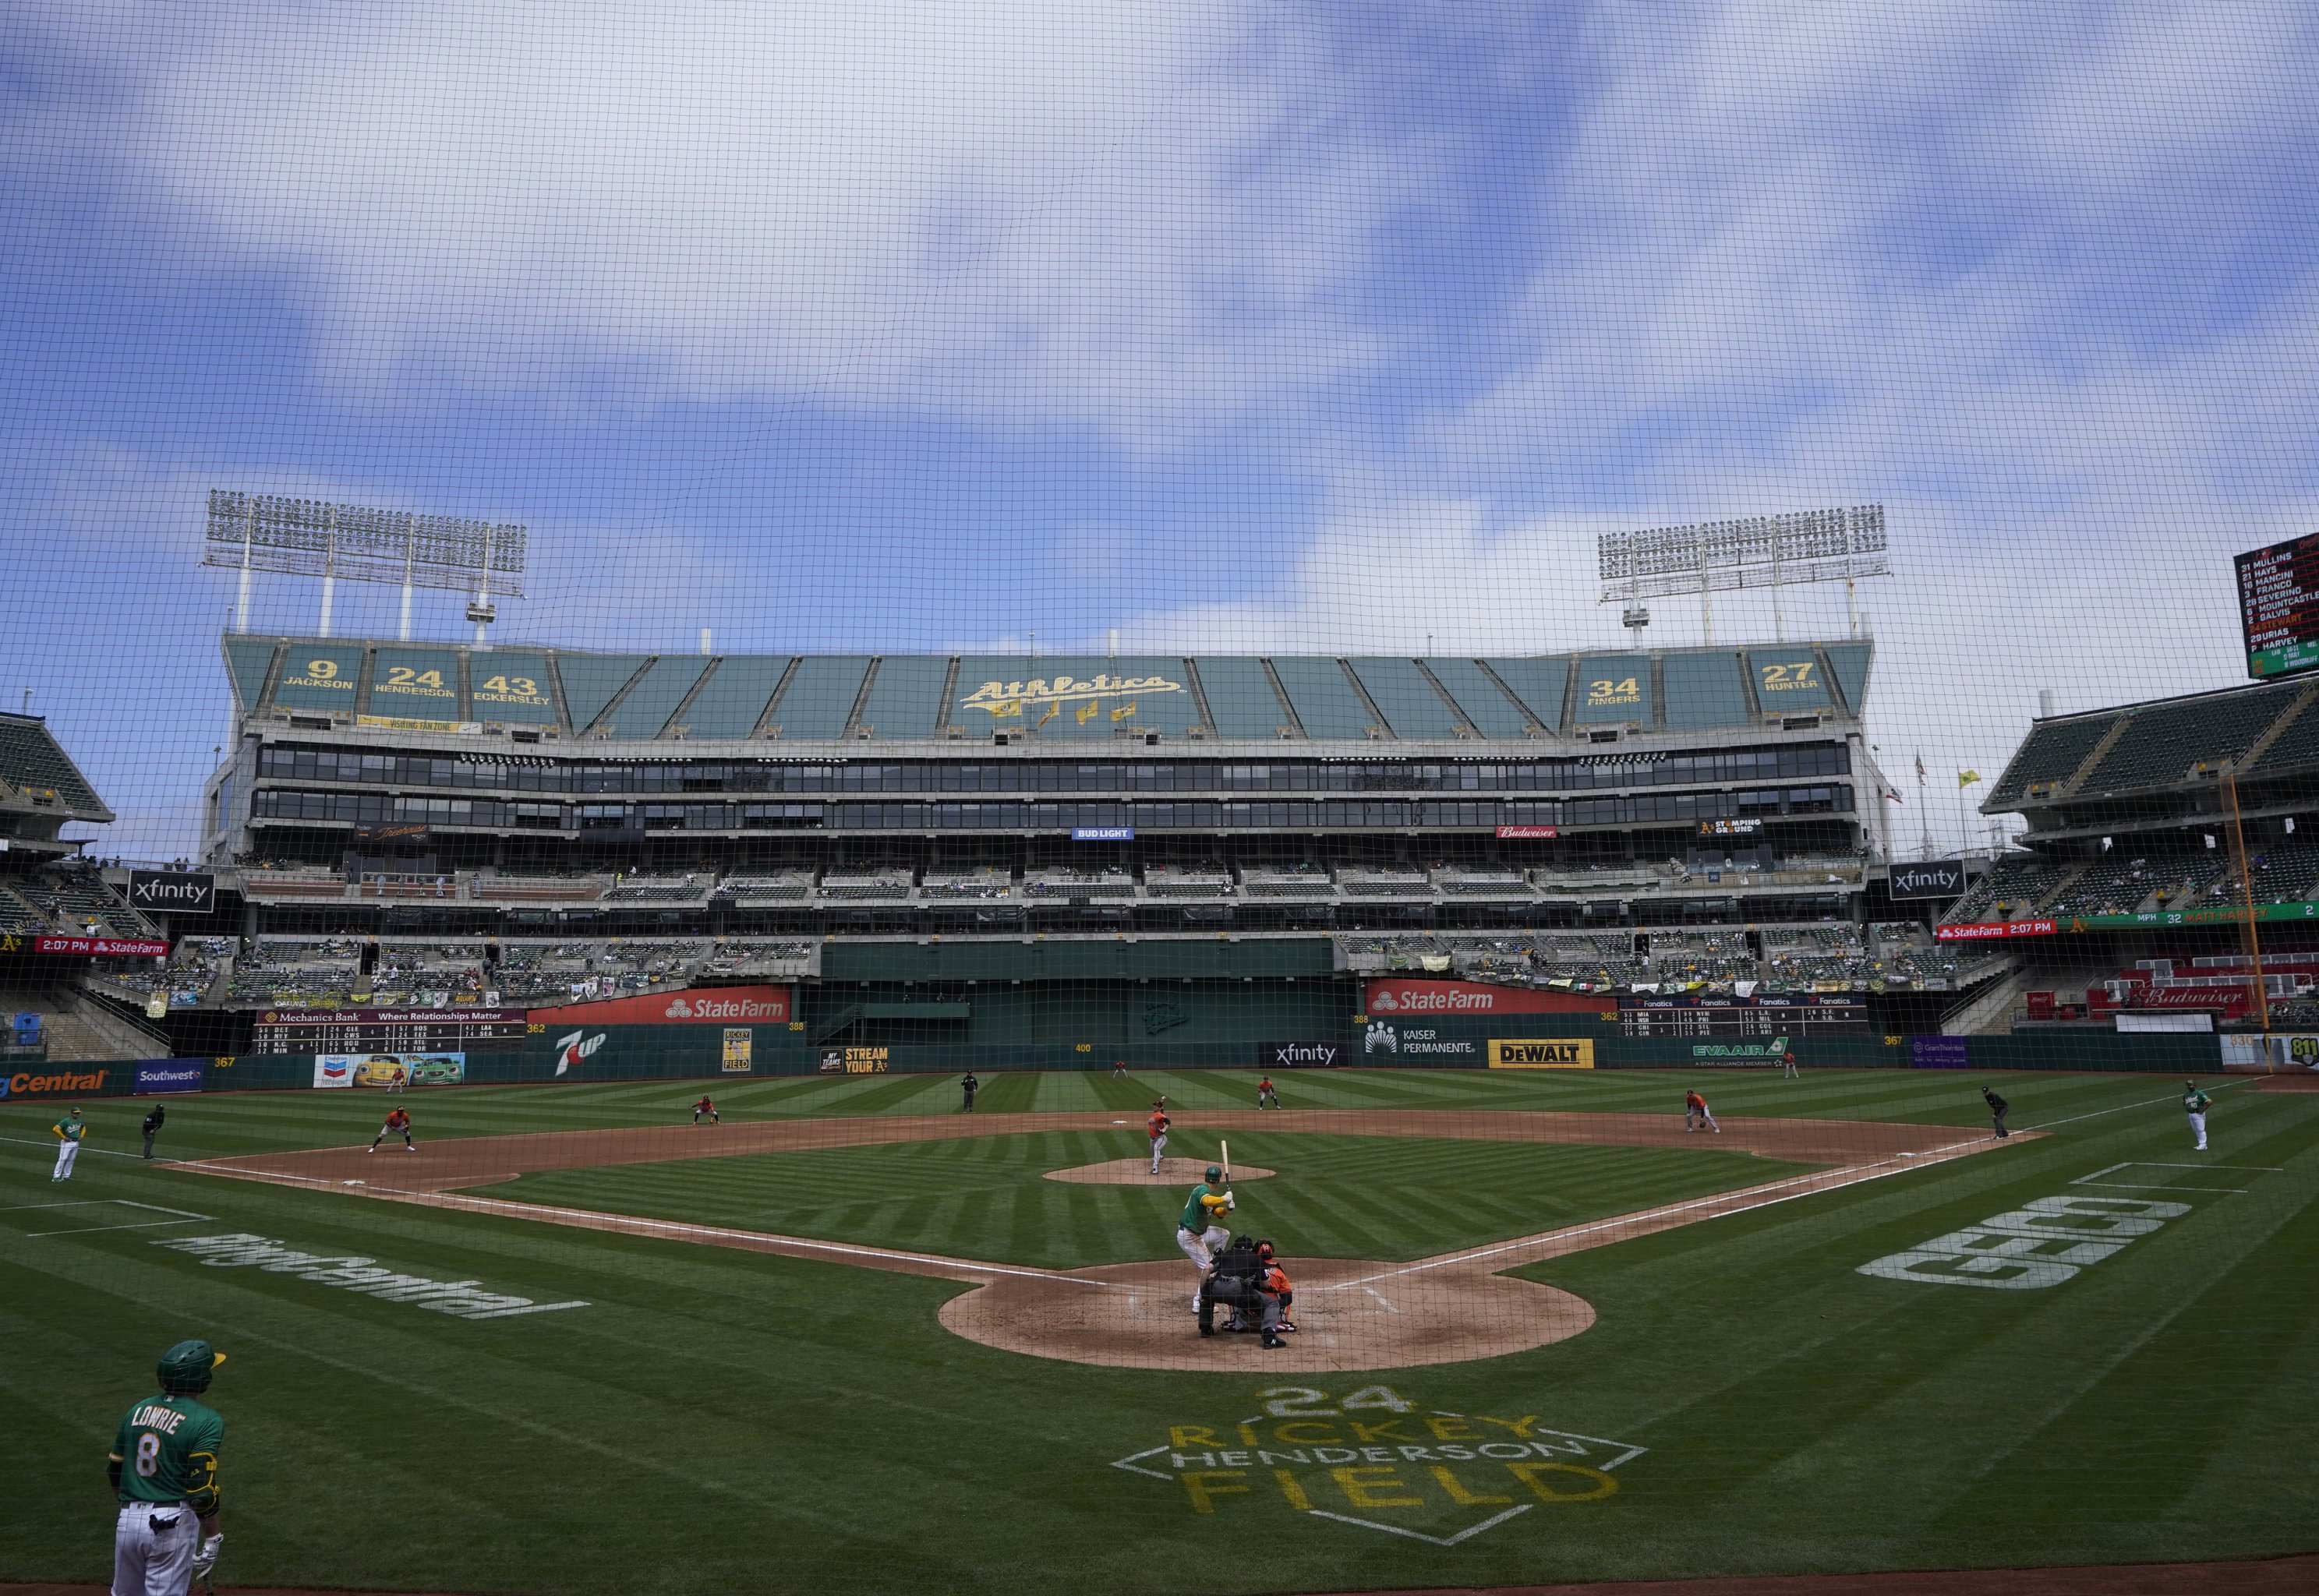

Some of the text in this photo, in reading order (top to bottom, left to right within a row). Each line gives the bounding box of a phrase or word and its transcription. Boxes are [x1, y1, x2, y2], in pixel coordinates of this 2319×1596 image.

[2241, 553, 2292, 572] 31 MULLINS
[2254, 566, 2276, 577] HAYS
[2243, 570, 2293, 589] 16 MANCINI
[2257, 580, 2292, 595] FRANCO
[2257, 587, 2301, 604] SEVERINO
[2258, 591, 2319, 613] MOUNTCASTLE
[2260, 608, 2291, 621] GALVIS
[2261, 613, 2302, 630] STEWART
[2262, 627, 2289, 640] URIAS
[2263, 636, 2297, 650] HARVEY
[308, 661, 338, 679] 9
[388, 667, 444, 688] 24
[1762, 662, 1813, 683] 27
[285, 677, 353, 690] JACKSON
[375, 684, 454, 698] HENDERSON
[483, 676, 538, 696] 43
[1589, 678, 1639, 698] 34
[1765, 680, 1818, 691] HUNTER
[474, 693, 550, 705] ECKERSLEY
[960, 674, 1181, 709] Athletics
[1588, 695, 1640, 706] FINGERS
[391, 719, 418, 729] VISITING
[420, 722, 433, 730] FAN
[374, 824, 428, 840] Treehouse
[1498, 826, 1554, 837] Budweiser
[1896, 869, 1957, 892] xfinity
[136, 879, 207, 902] xfinity
[2137, 913, 2156, 922] MPH
[2167, 914, 2182, 923] 32
[2185, 913, 2215, 922] MATT
[2305, 906, 2314, 916] 2
[2010, 924, 2031, 934] 2:07
[2034, 923, 2051, 932] PM
[44, 940, 68, 950] 2:07
[72, 941, 89, 951] PM
[2140, 988, 2243, 1006] Budweiser
[280, 1013, 332, 1022] Mechanics
[335, 1013, 359, 1022] Bank
[527, 1024, 545, 1033] 362
[789, 1022, 804, 1031] 388
[1404, 1029, 1436, 1040] KAISER
[1884, 1036, 1902, 1045] 367
[2232, 1035, 2254, 1046] 330
[845, 1047, 888, 1060] STREAM
[1076, 1043, 1091, 1052] 400
[1276, 1043, 1336, 1065] xfinity
[1404, 1043, 1471, 1053] PERMANENTE
[2291, 1037, 2318, 1057] 811
[214, 1058, 235, 1068] 367
[845, 1061, 873, 1072] YOUR
[140, 1070, 193, 1081] Southwest
[1854, 1195, 2193, 1290] GEICO
[1255, 1385, 1416, 1418] 24
[131, 1405, 187, 1436] LOWRIE
[1168, 1414, 1542, 1449] RICKEY
[136, 1431, 161, 1478] 8
[1171, 1439, 1592, 1468] HENDERSON
[1179, 1461, 1621, 1514] FIELD
